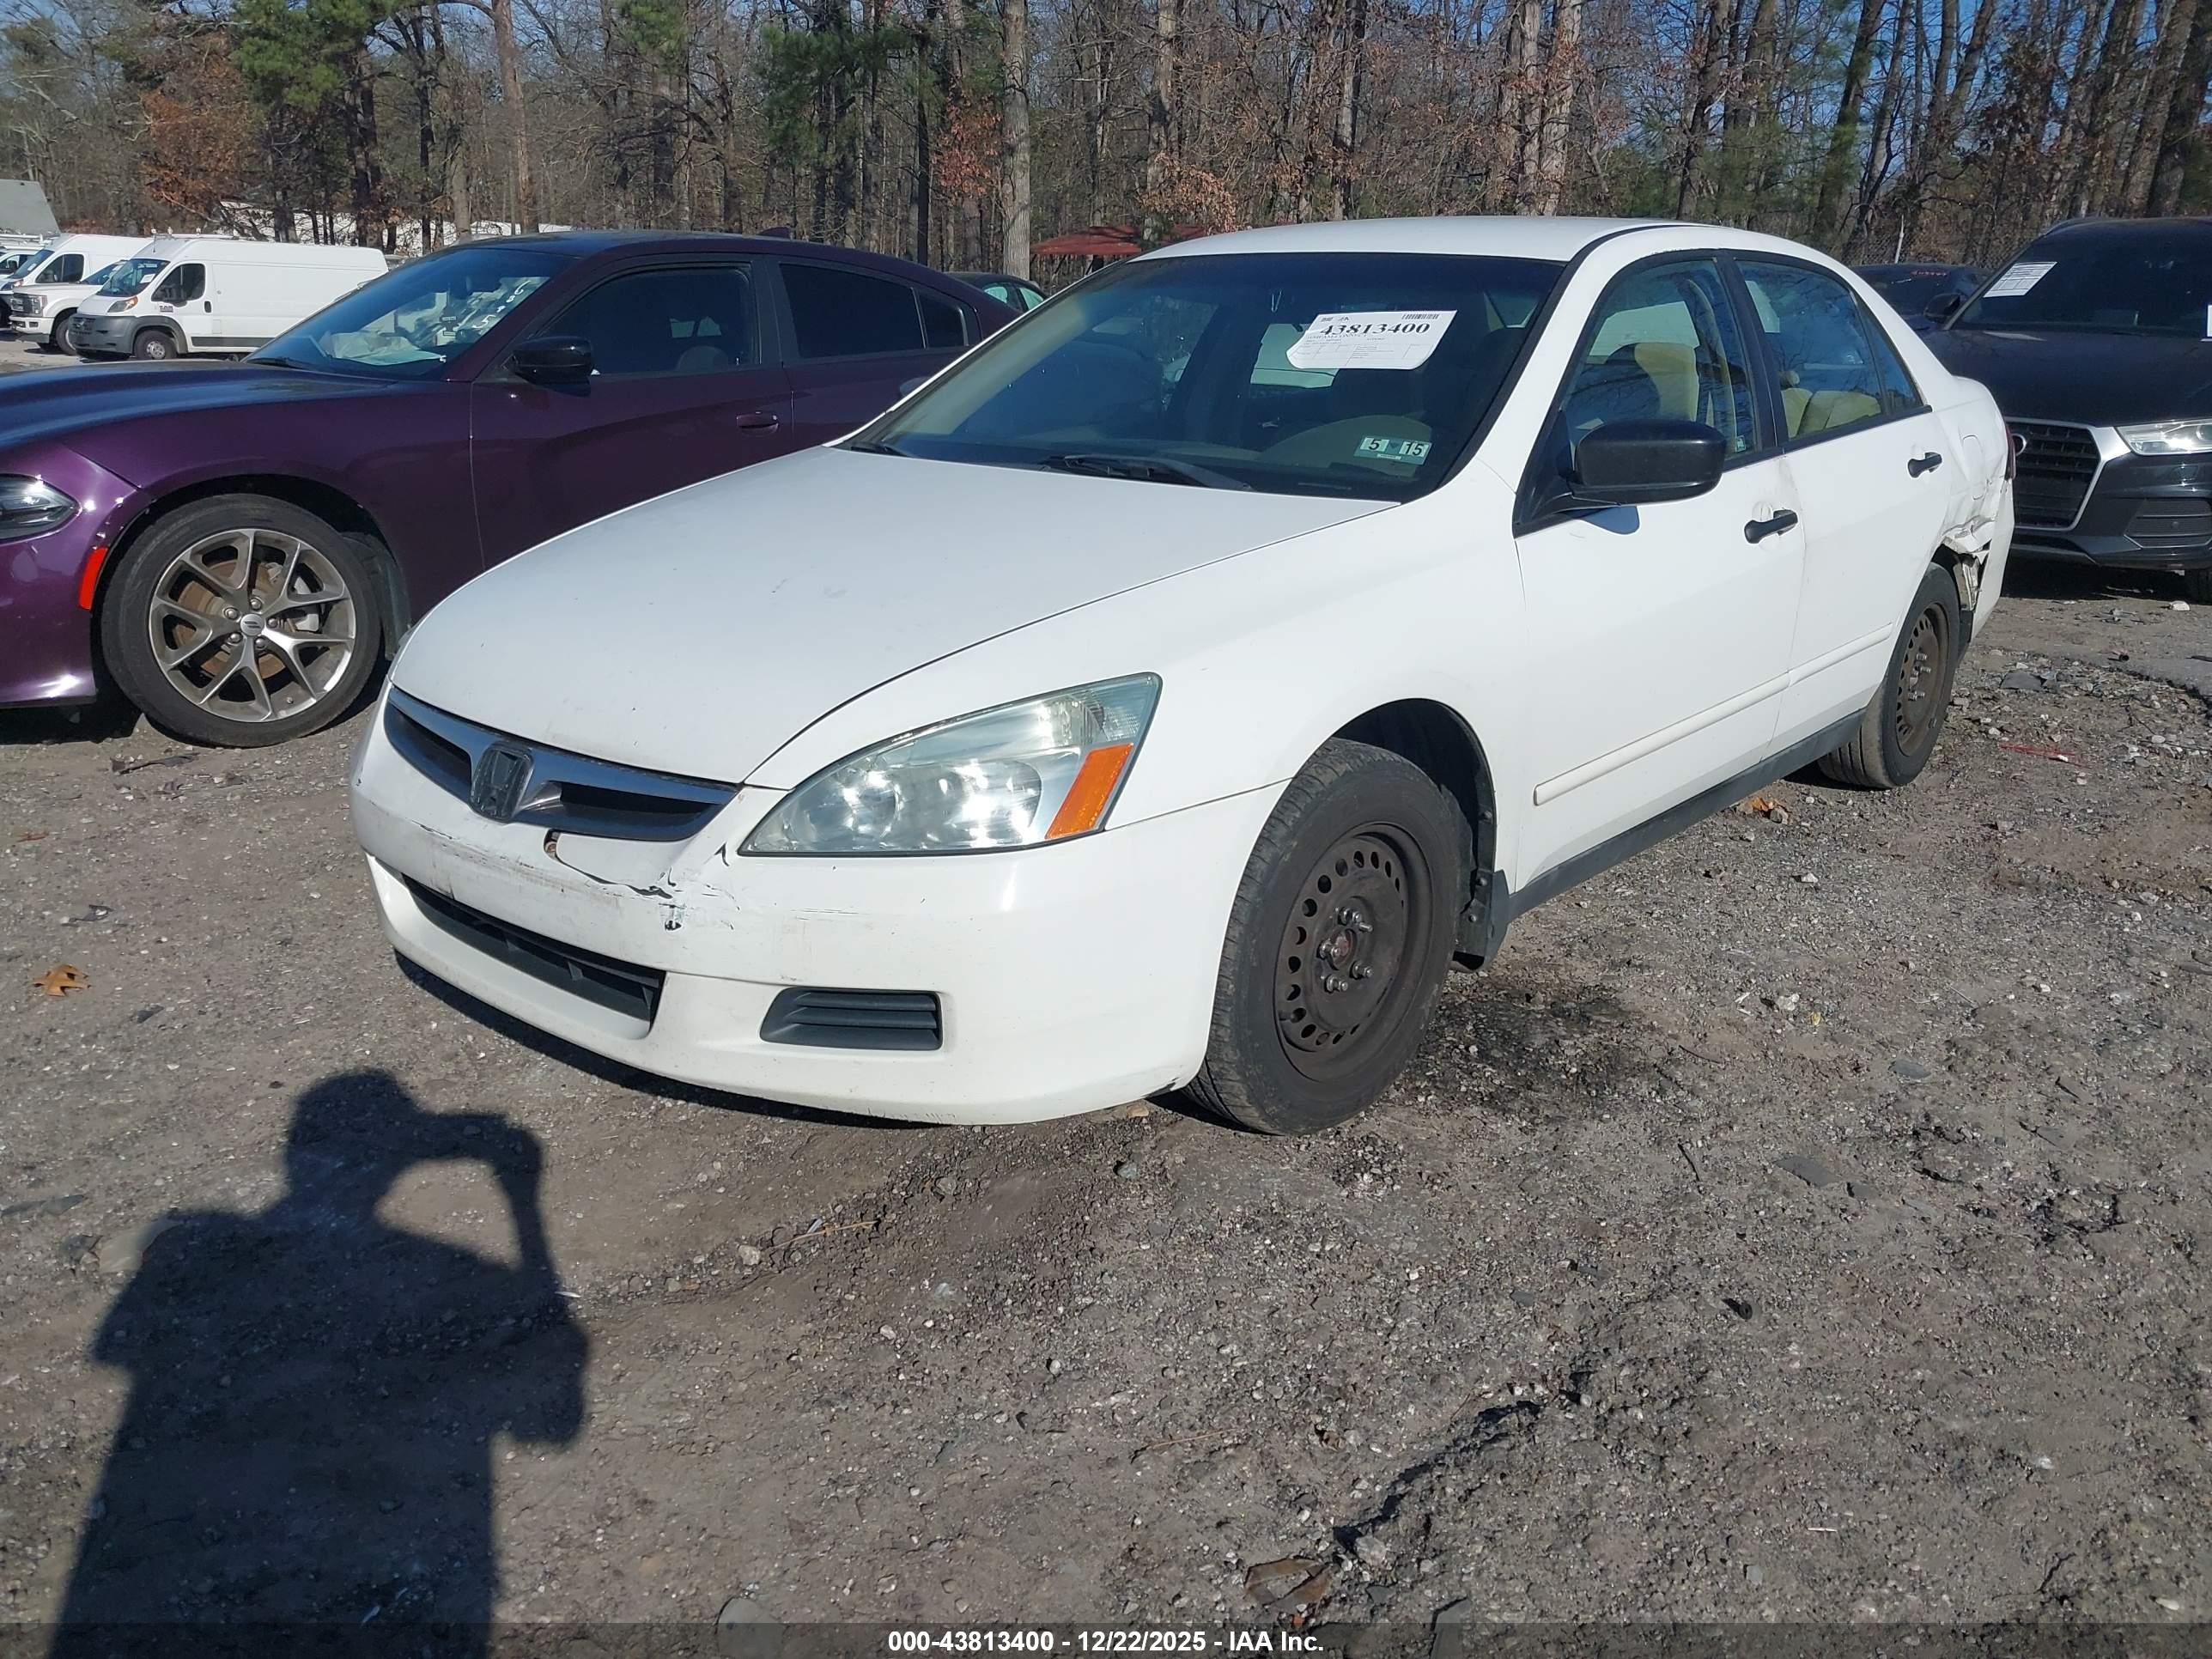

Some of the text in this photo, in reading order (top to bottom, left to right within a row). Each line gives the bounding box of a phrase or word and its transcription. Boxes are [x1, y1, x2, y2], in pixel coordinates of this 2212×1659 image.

[1320, 324, 1430, 335] 43813400
[1369, 439, 1422, 456] 5 15
